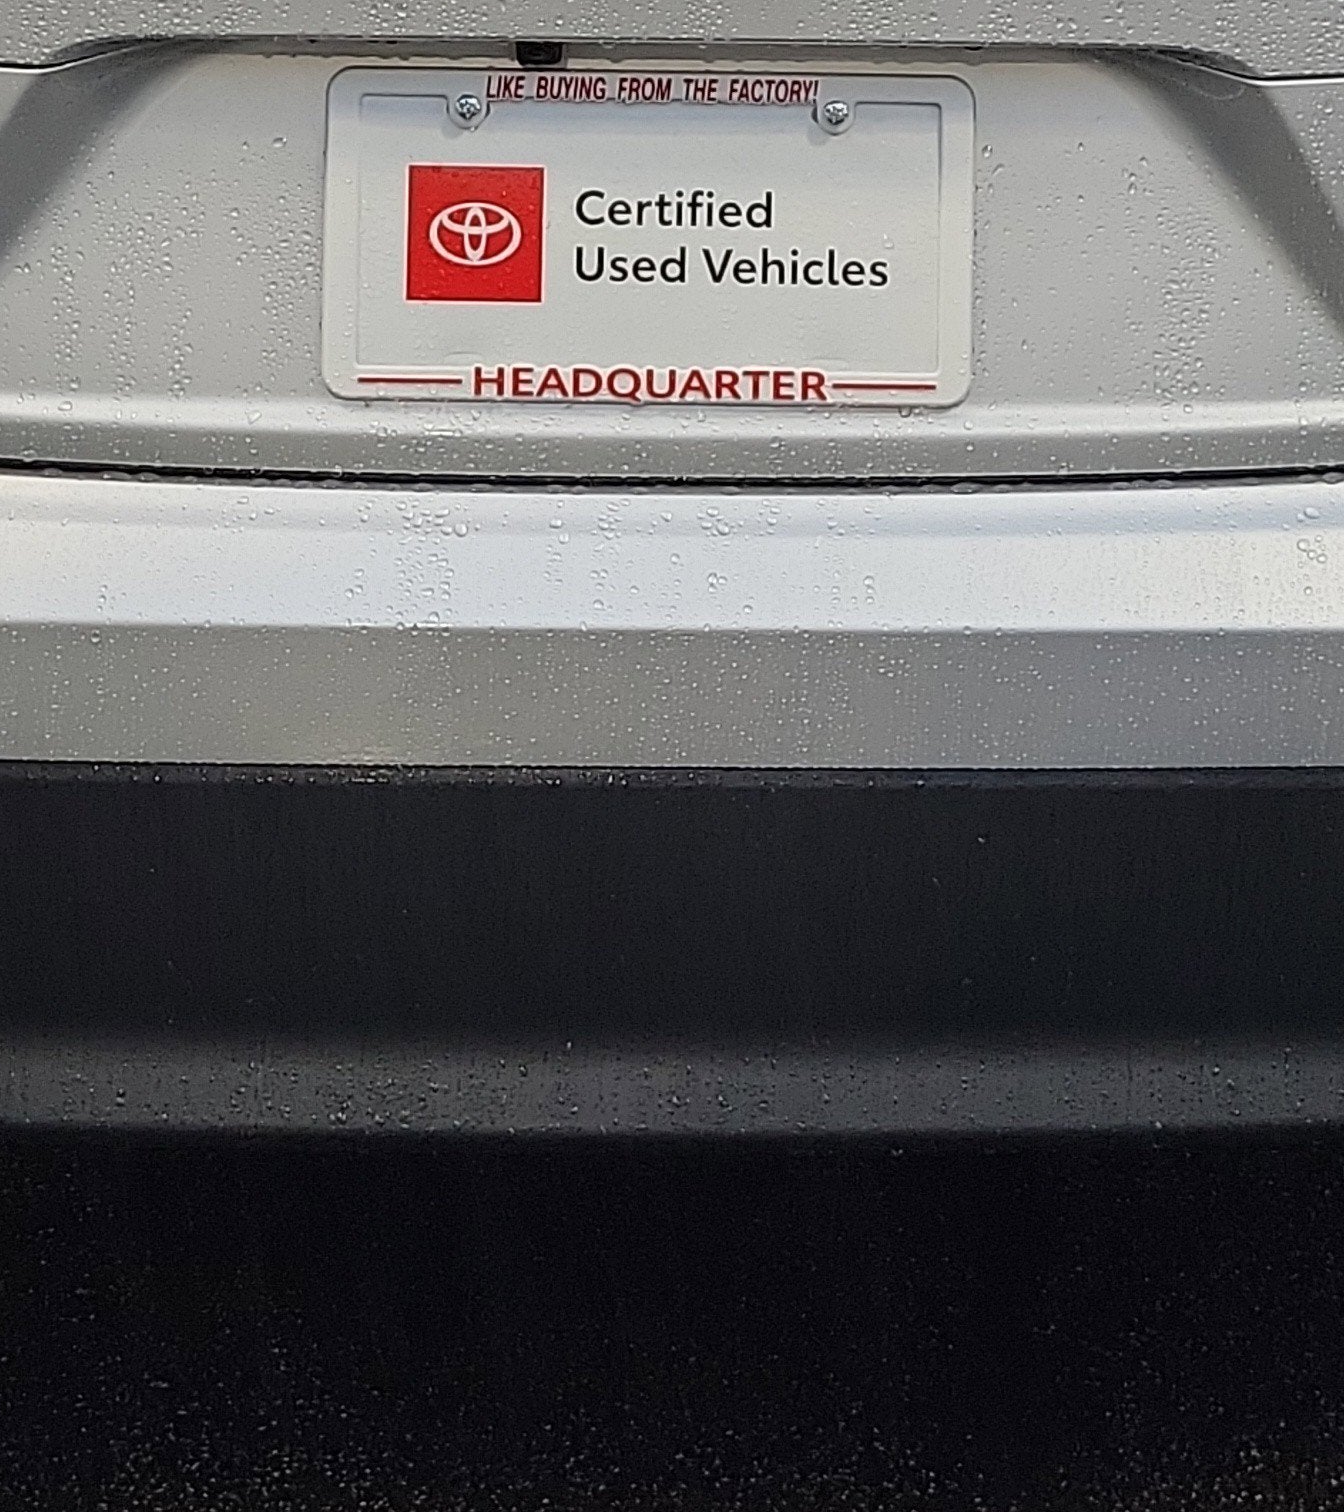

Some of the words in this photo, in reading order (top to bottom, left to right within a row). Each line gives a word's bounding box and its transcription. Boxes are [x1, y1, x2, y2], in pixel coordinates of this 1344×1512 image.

[486, 75, 526, 99] LIKE
[536, 76, 607, 101] BUYING
[617, 77, 673, 101] FROM
[683, 78, 719, 102] THE
[728, 78, 819, 103] FACTORY!
[575, 189, 774, 228] Certified
[575, 245, 687, 283] Used
[702, 247, 889, 287] Vehicles
[473, 366, 828, 402] HEADQUARTER
